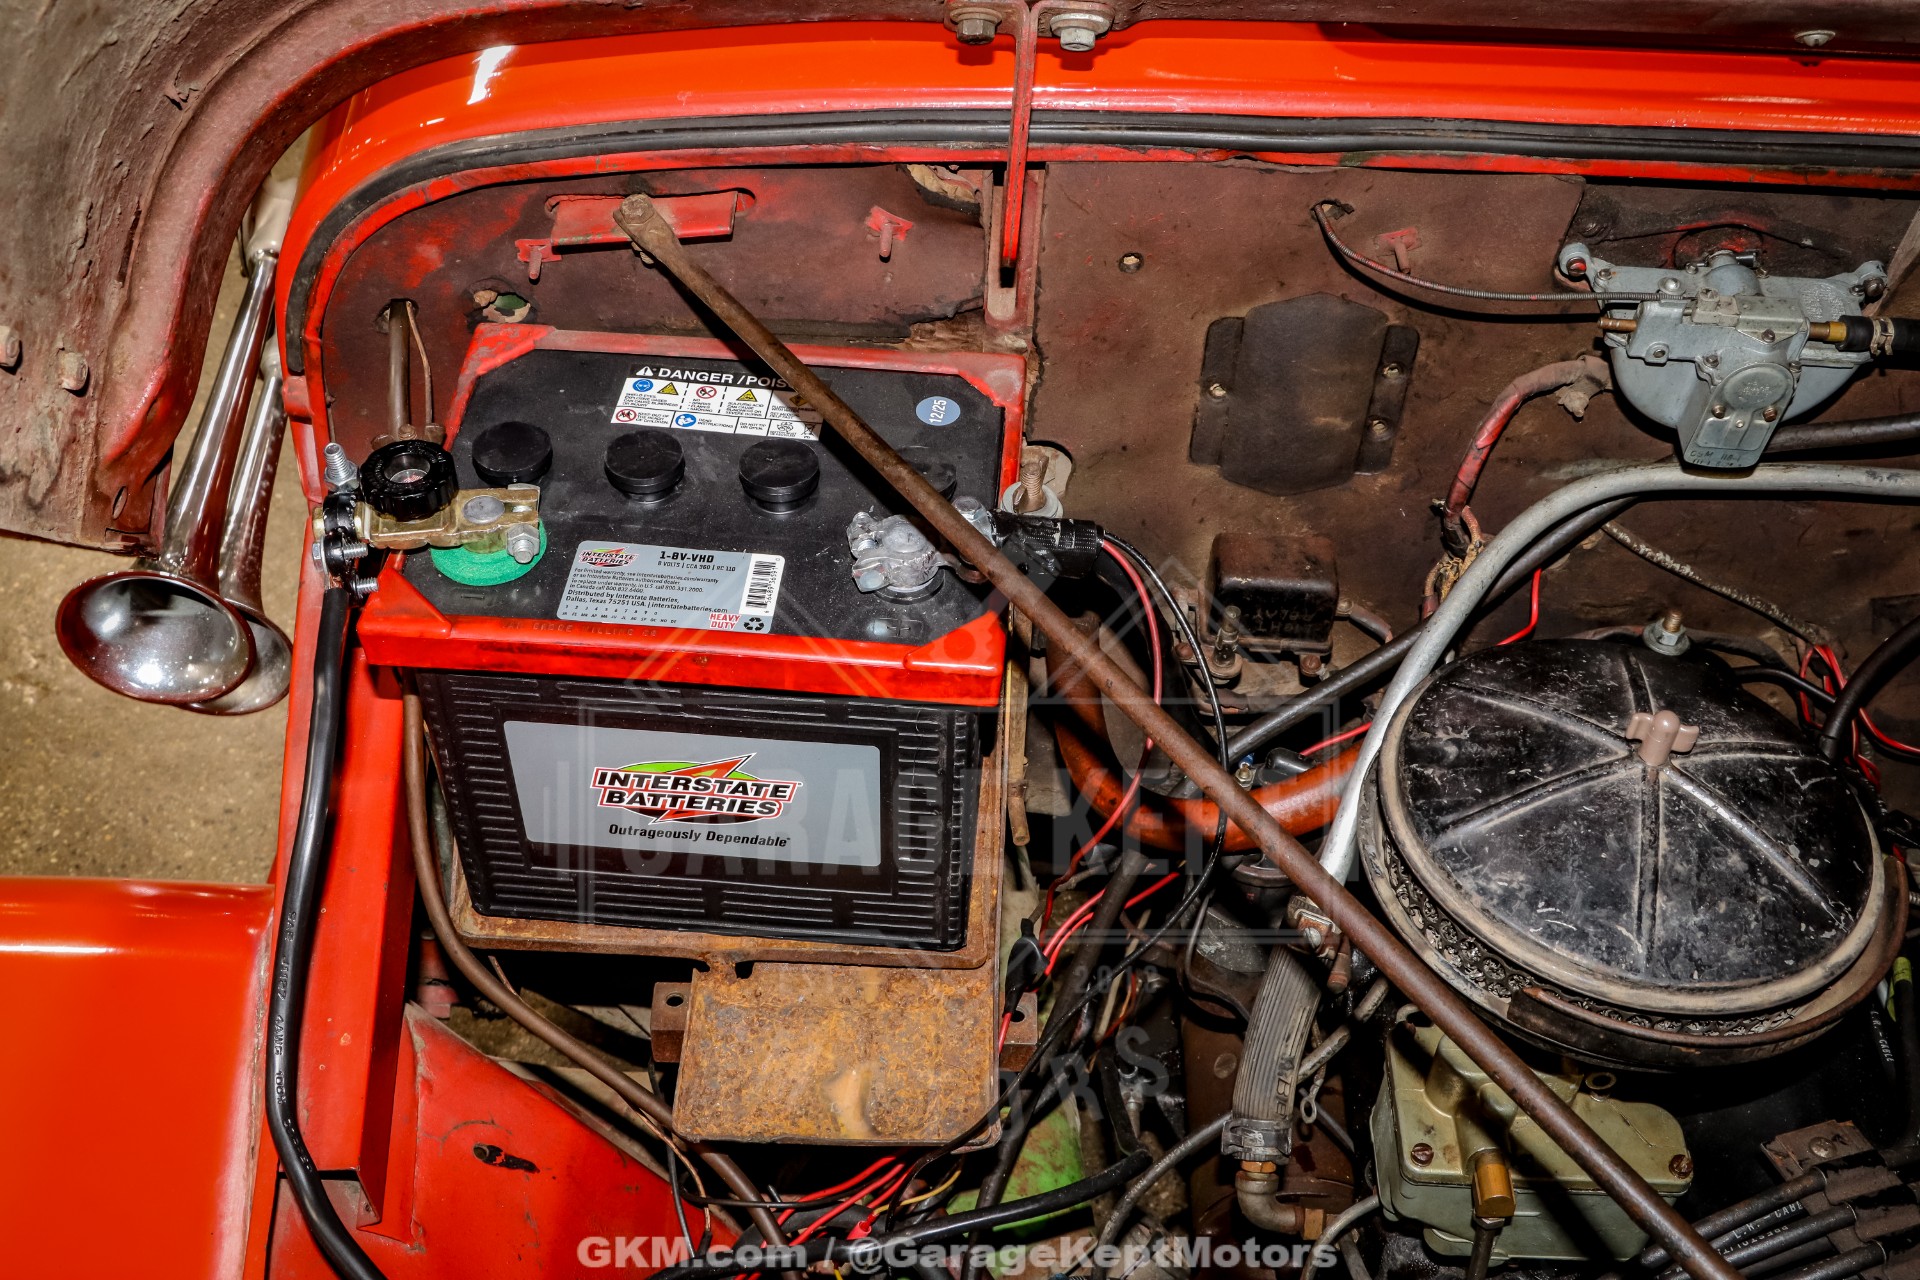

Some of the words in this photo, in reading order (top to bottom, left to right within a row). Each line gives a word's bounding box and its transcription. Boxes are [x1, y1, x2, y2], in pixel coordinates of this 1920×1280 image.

[658, 368, 734, 384] DANGER
[737, 375, 790, 388] /POIS
[929, 400, 947, 424] 12/25
[582, 551, 635, 560] INTERSTATE
[582, 557, 629, 565] BATTERIES
[659, 551, 715, 563] 1-8V-VHD
[565, 596, 587, 604] Dallas,
[651, 601, 728, 614] interstatebatteries.com
[567, 590, 605, 598] Distributed
[615, 593, 647, 601] Interstate
[648, 595, 680, 604] Batteries,
[709, 613, 741, 623] HEAVY
[711, 621, 736, 630] DUTY
[598, 771, 791, 799] INTERSTATE
[605, 789, 780, 816] BATTERIES
[608, 823, 702, 842] Outrageously
